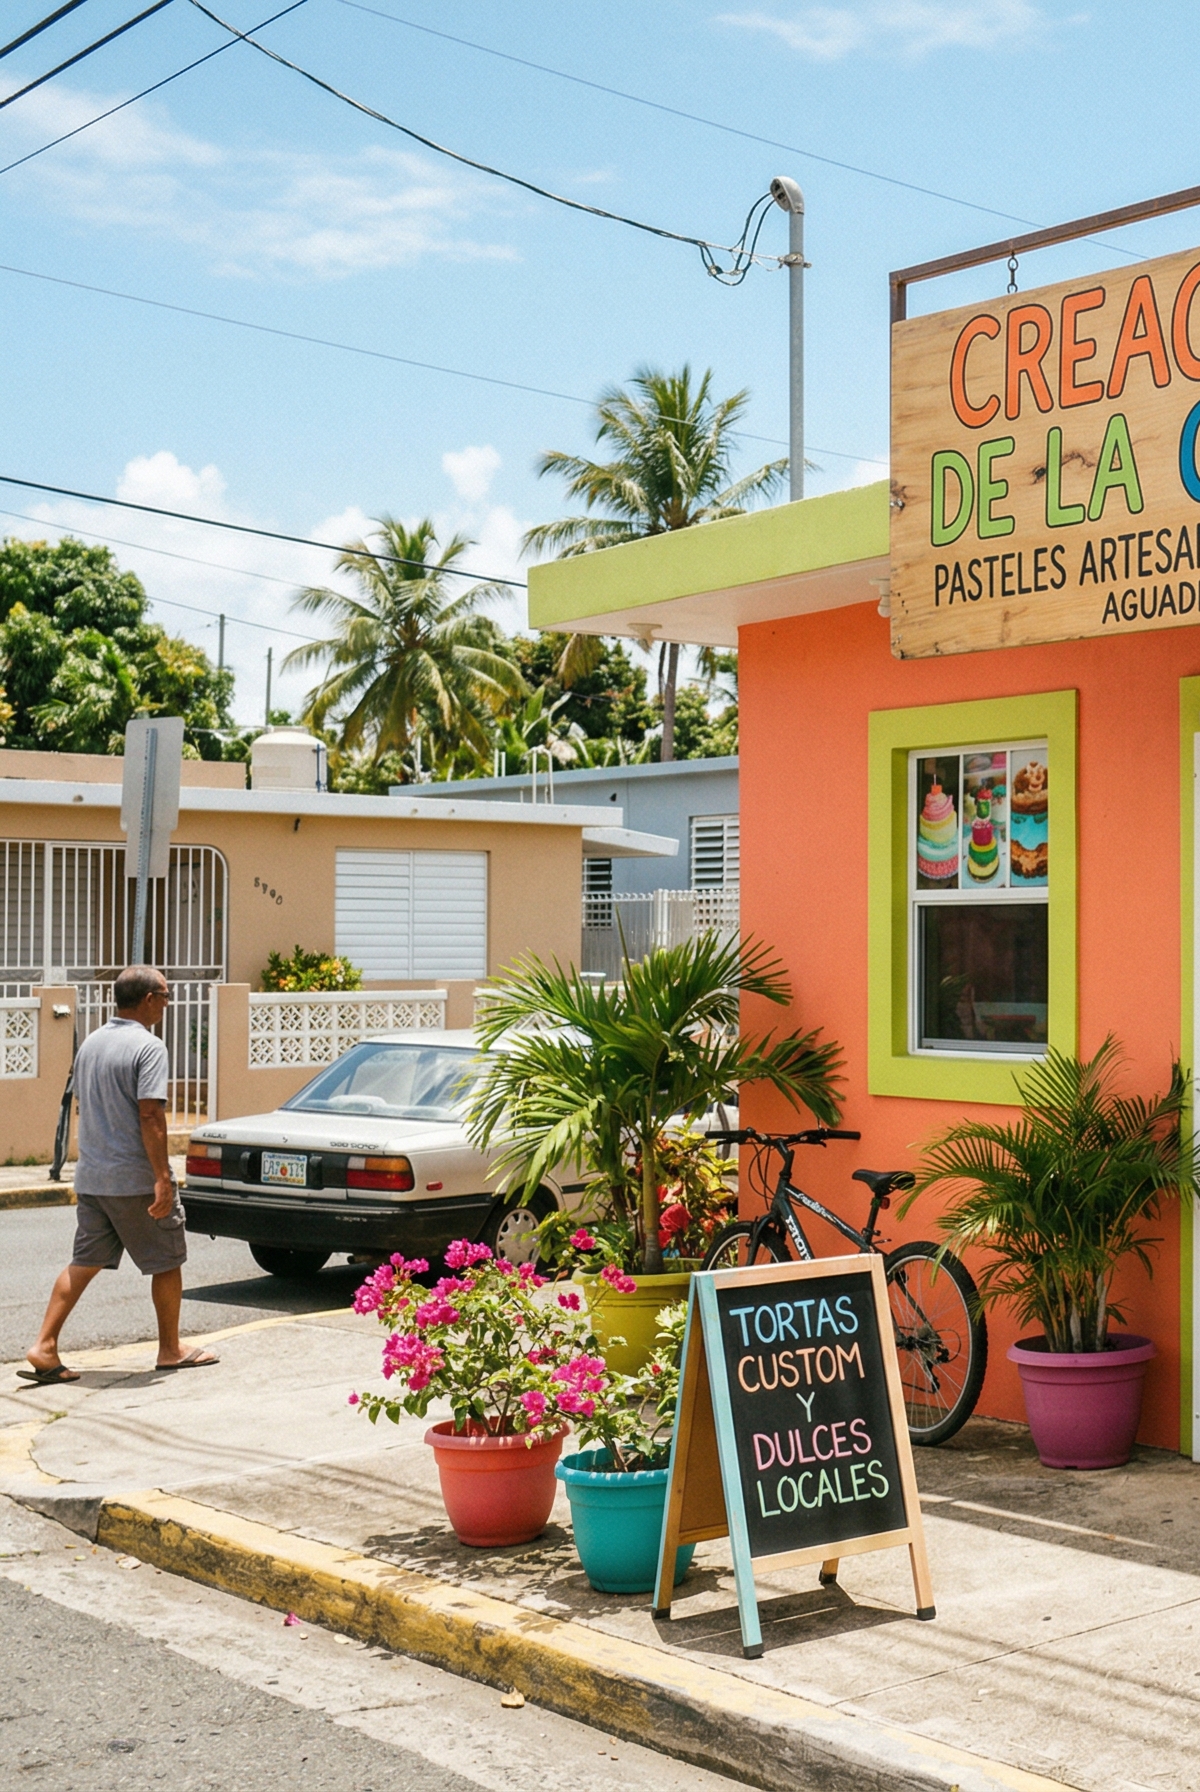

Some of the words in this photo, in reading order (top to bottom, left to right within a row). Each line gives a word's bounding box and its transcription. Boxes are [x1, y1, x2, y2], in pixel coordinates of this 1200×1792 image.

[930, 434, 1016, 549] DE
[1045, 412, 1146, 529] LA
[933, 544, 1067, 607] PASTELES
[729, 1295, 859, 1347] TORTAS
[738, 1341, 865, 1393] CUSTOM
[796, 1391, 816, 1423] Y
[753, 1418, 872, 1471] DULCES
[757, 1459, 890, 1518] LOCALES
